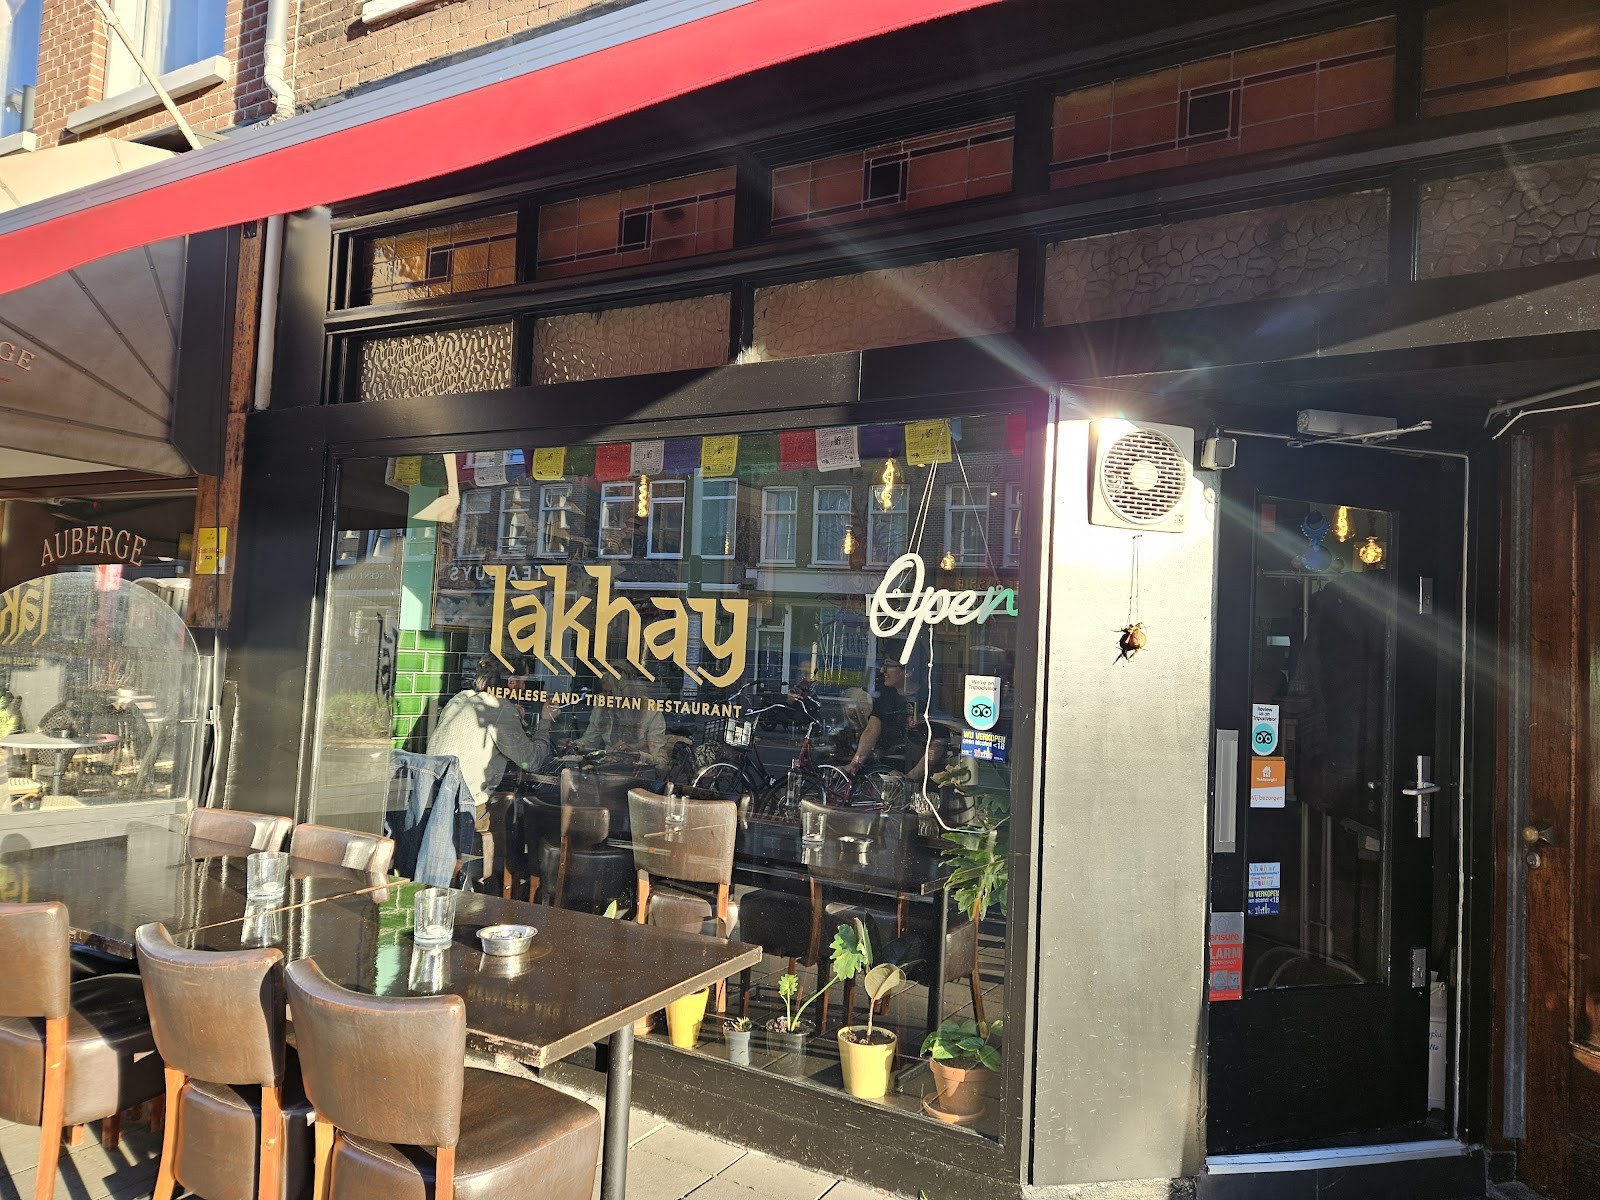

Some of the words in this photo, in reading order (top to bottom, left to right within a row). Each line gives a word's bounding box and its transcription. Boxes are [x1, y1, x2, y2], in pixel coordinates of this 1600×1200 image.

[40, 525, 147, 567] AUBERGE
[869, 552, 1019, 665] Open
[968, 684, 997, 692] Tripadvisor
[486, 686, 547, 703] NEPALESE
[552, 691, 580, 705] AND
[585, 694, 641, 711] TIBETAN
[647, 699, 742, 719] RESTAURANT
[975, 732, 1006, 744] VERKOPEN
[993, 742, 1005, 751] <18
[1259, 794, 1283, 802] bezorgen
[1255, 889, 1280, 898] VERKOPEN
[1270, 896, 1279, 904] <18
